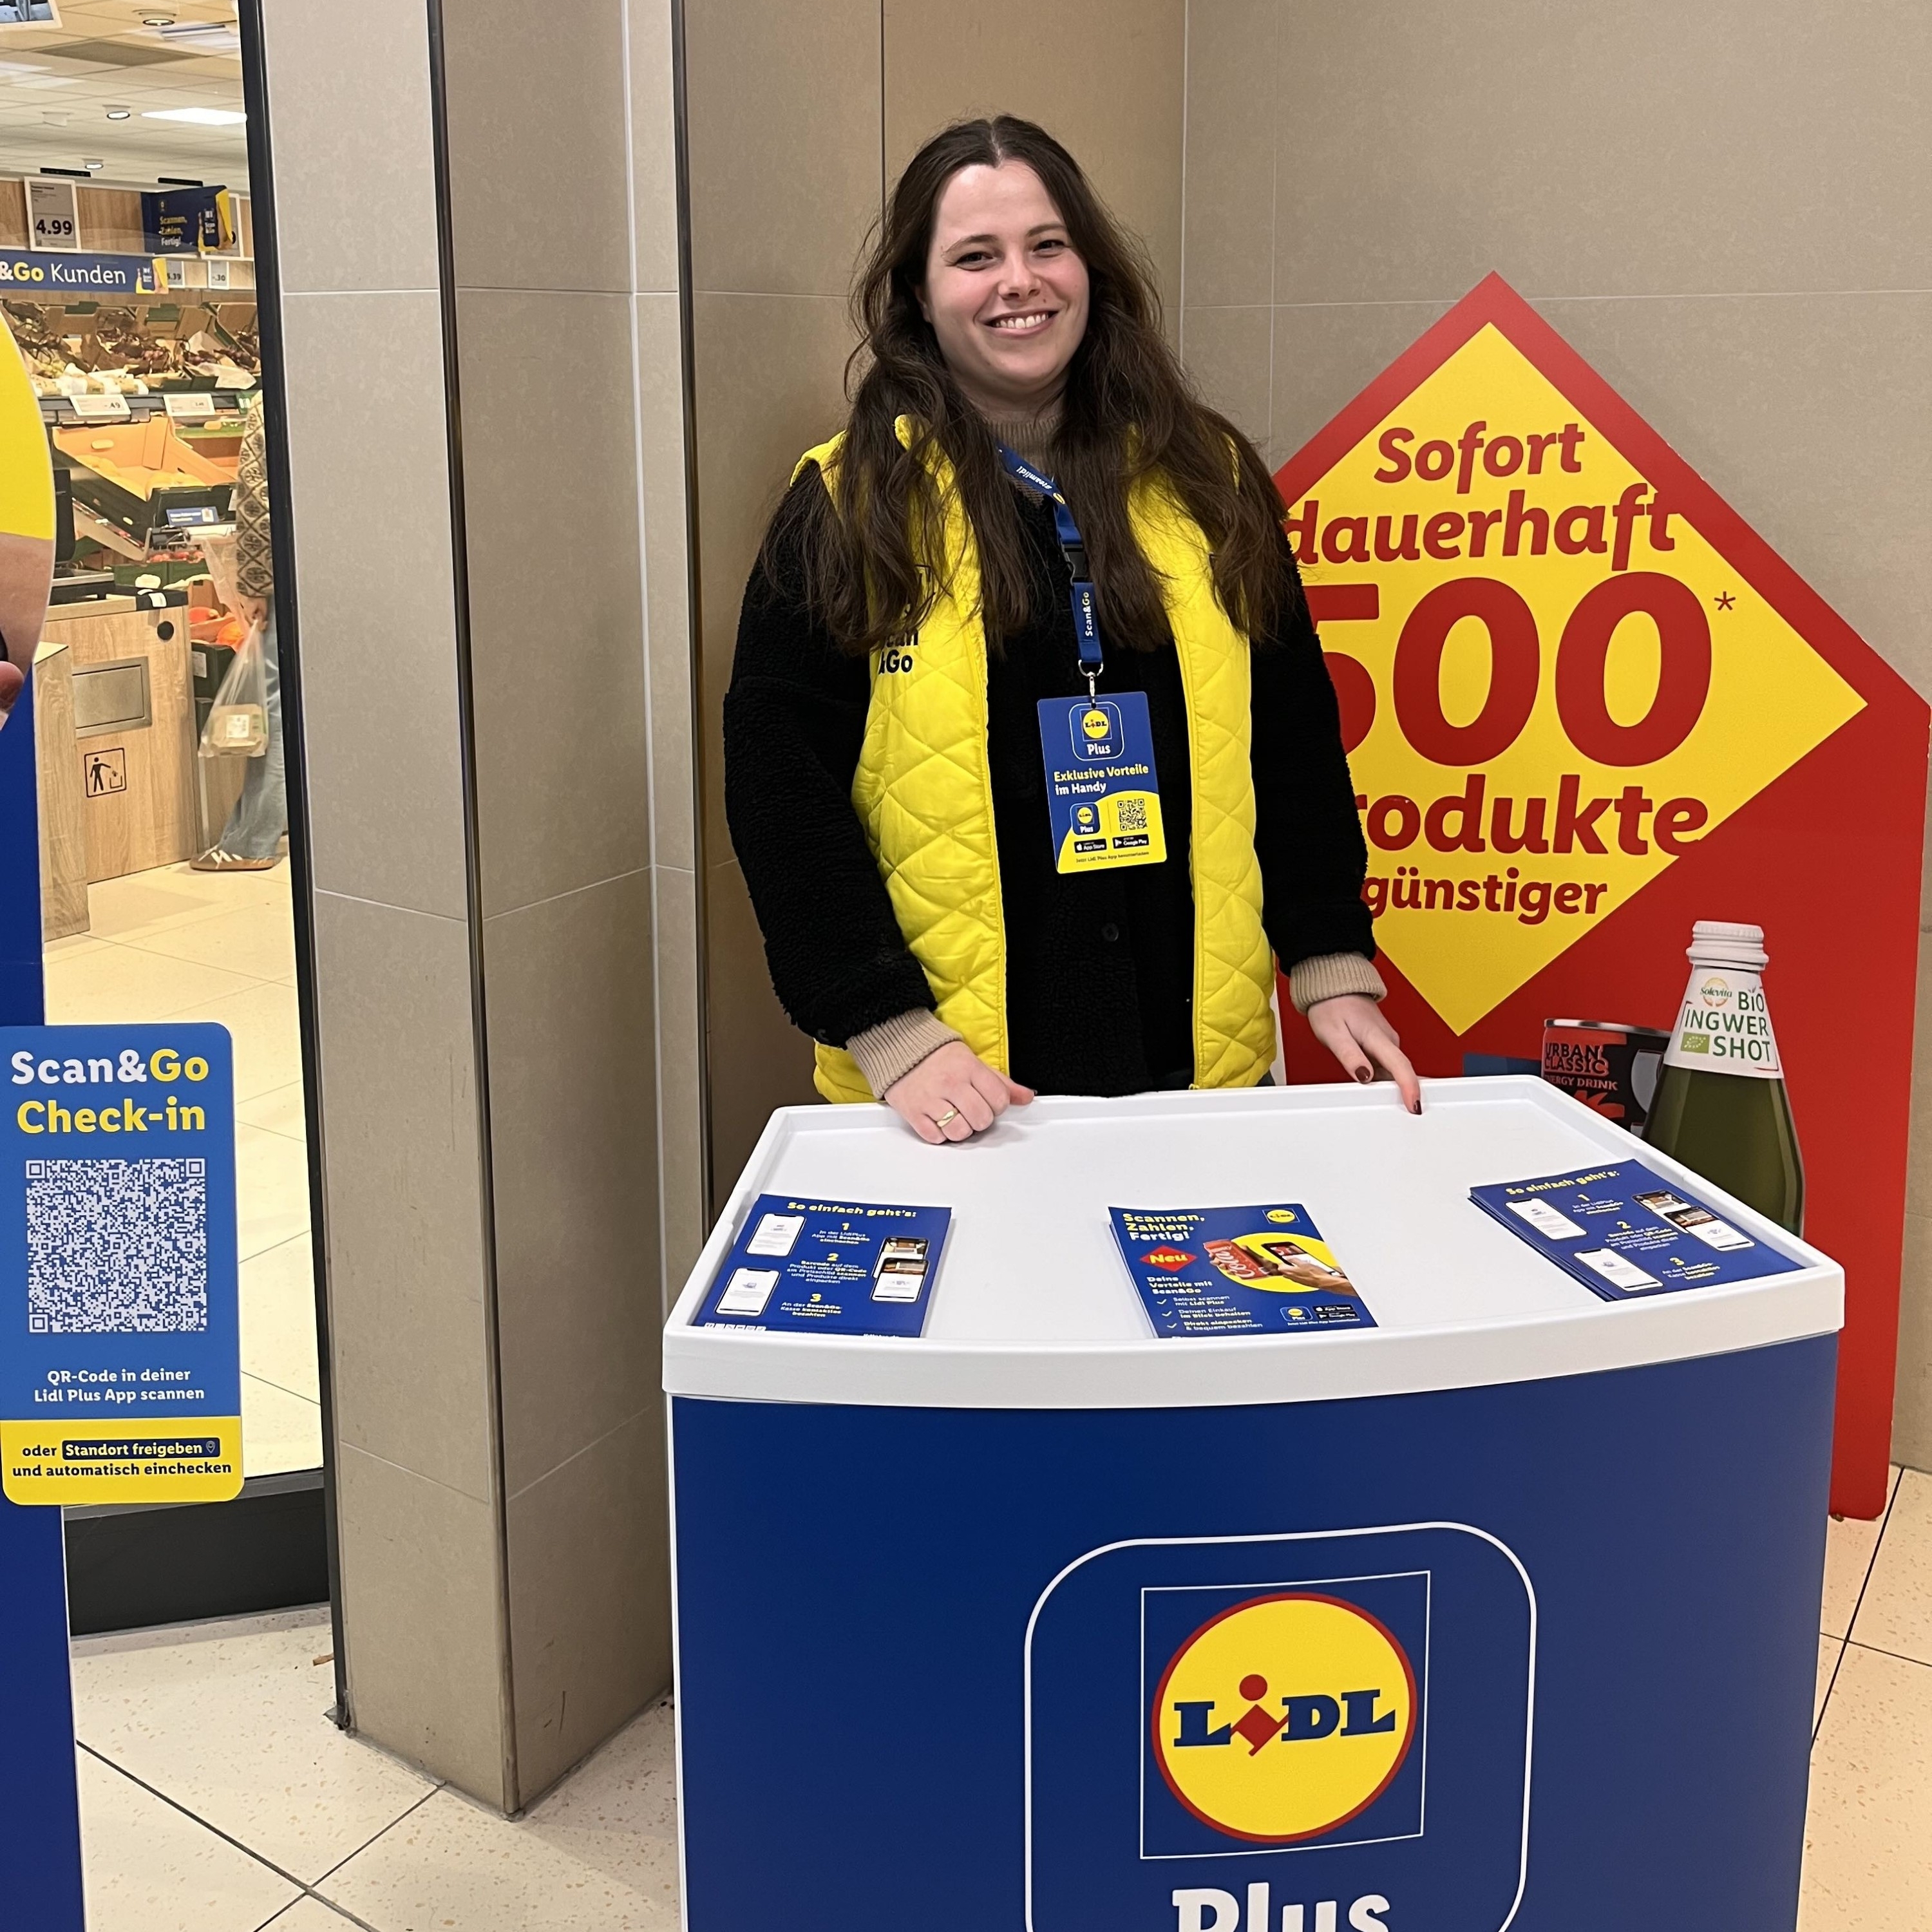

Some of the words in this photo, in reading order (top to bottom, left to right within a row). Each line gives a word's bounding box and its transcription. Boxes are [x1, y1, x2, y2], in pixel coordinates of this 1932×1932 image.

[36, 219, 73, 235] 4.99
[51, 263, 126, 284] Kunden
[1374, 421, 1585, 494] Sofort
[1287, 483, 1676, 571] dauerhaft
[1081, 591, 1094, 636] Scan&Go
[1086, 743, 1111, 755] Plus
[1054, 768, 1105, 782] Exklusive
[1106, 763, 1149, 777] Vorteile
[1055, 784, 1070, 795] im
[1071, 781, 1107, 794] Handy
[1355, 774, 1709, 857] odukte
[1360, 867, 1608, 925] günstiger
[1700, 987, 1733, 998] Solevita
[1684, 1009, 1769, 1037] INGWER
[1546, 1042, 1600, 1061] URBAN
[1712, 1035, 1770, 1062] SHOT
[11, 1048, 209, 1085] Scan&Go
[1544, 1056, 1606, 1075] CLASSIC
[1577, 1077, 1619, 1091] DRINK
[17, 1096, 205, 1133] Check-in
[787, 1202, 806, 1210] So
[808, 1204, 864, 1215] einfach
[1122, 1213, 1206, 1222] Scannen,
[1125, 1222, 1195, 1231] Zahlen,
[1129, 1231, 1190, 1242] Fertig!
[827, 1253, 839, 1262] 2
[1149, 1253, 1189, 1264] Neu
[810, 1293, 822, 1302] 3
[47, 1370, 118, 1385] QR-Code
[121, 1368, 137, 1382] in
[140, 1368, 191, 1382] deiner
[34, 1389, 63, 1402] Lidl
[67, 1389, 101, 1402] Plus
[104, 1388, 137, 1404] App
[140, 1389, 205, 1400] scannen
[22, 1444, 57, 1457] oder
[66, 1443, 129, 1456] Standort
[133, 1442, 203, 1458] freigeben
[12, 1465, 42, 1477] und
[46, 1463, 140, 1476] automatisch
[144, 1462, 232, 1475] einchecken
